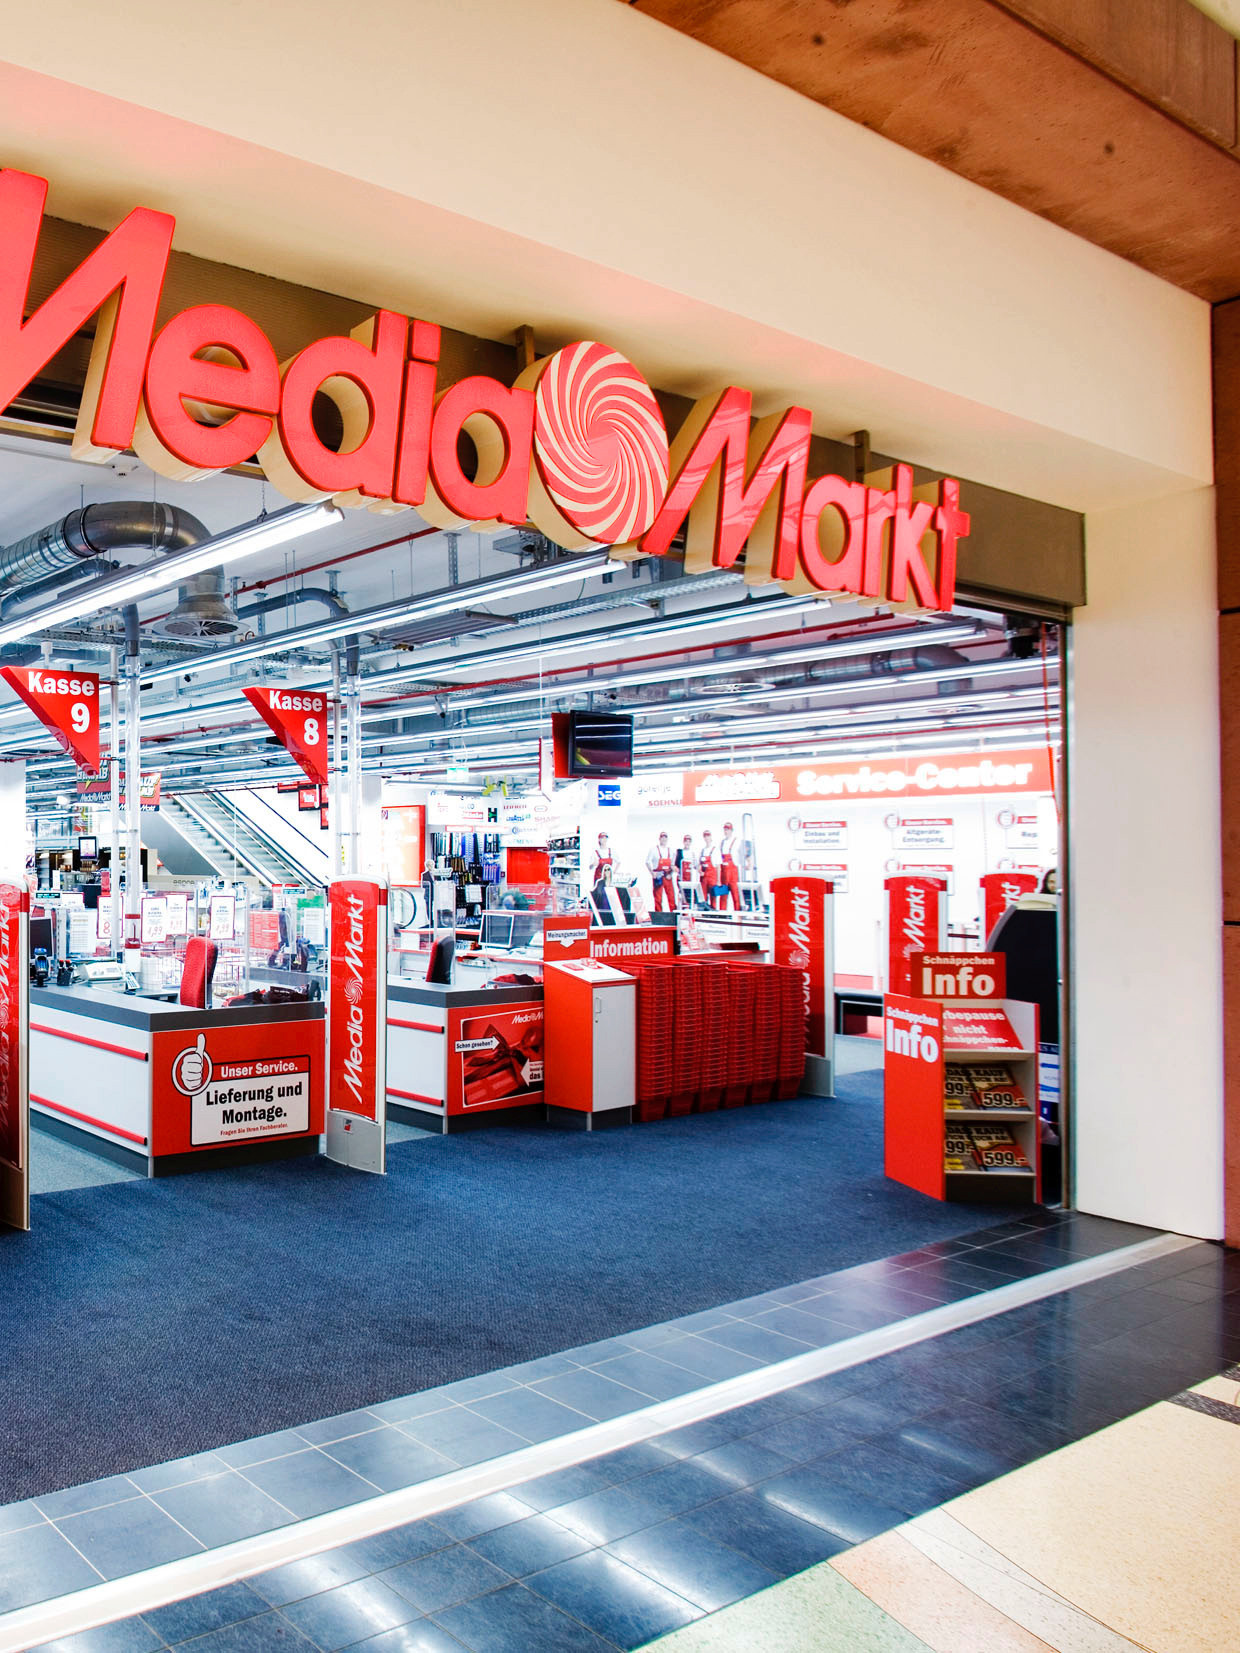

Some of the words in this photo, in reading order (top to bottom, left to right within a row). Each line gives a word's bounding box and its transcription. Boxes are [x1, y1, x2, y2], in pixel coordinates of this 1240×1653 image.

[27, 669, 96, 698] Kasse
[268, 689, 323, 713] Kasse
[70, 703, 91, 733] 9
[302, 716, 321, 746] 8
[589, 937, 669, 958] Information
[922, 955, 995, 967] Schnäppchen
[922, 966, 996, 996] Info
[952, 1024, 989, 1034] nicht
[886, 1018, 939, 1063] Info
[220, 1065, 253, 1078] Unser
[255, 1060, 298, 1075] Service.
[205, 1085, 274, 1106] Lieferung
[277, 1081, 303, 1098] und
[982, 1091, 1026, 1108] 599.-
[222, 1105, 288, 1124] Montage.
[220, 1128, 237, 1136] Fragen
[983, 1150, 1028, 1167] 599.-
